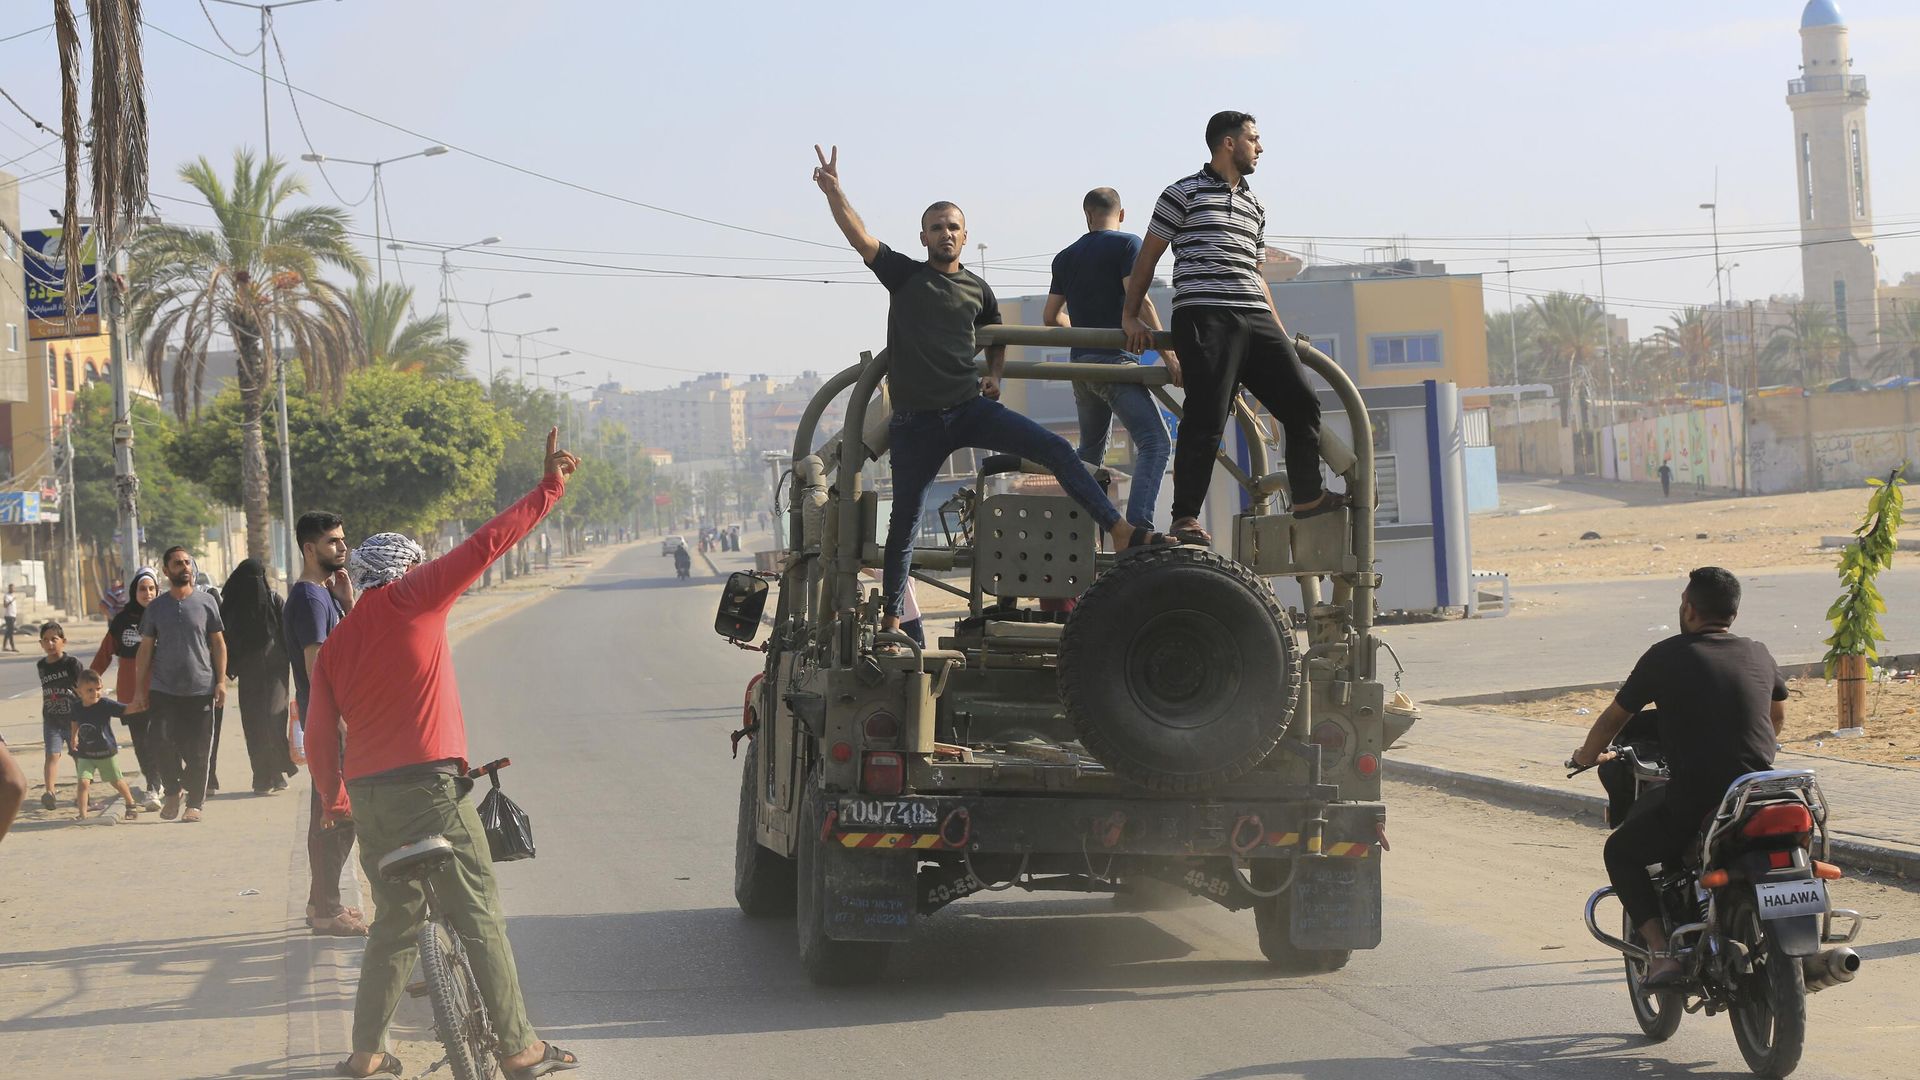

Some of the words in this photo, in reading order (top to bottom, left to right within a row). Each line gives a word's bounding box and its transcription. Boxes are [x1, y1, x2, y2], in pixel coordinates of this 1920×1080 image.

[29, 282, 96, 302] حودة
[1183, 870, 1230, 897] 40-80
[1764, 890, 1820, 908] HALAWA
